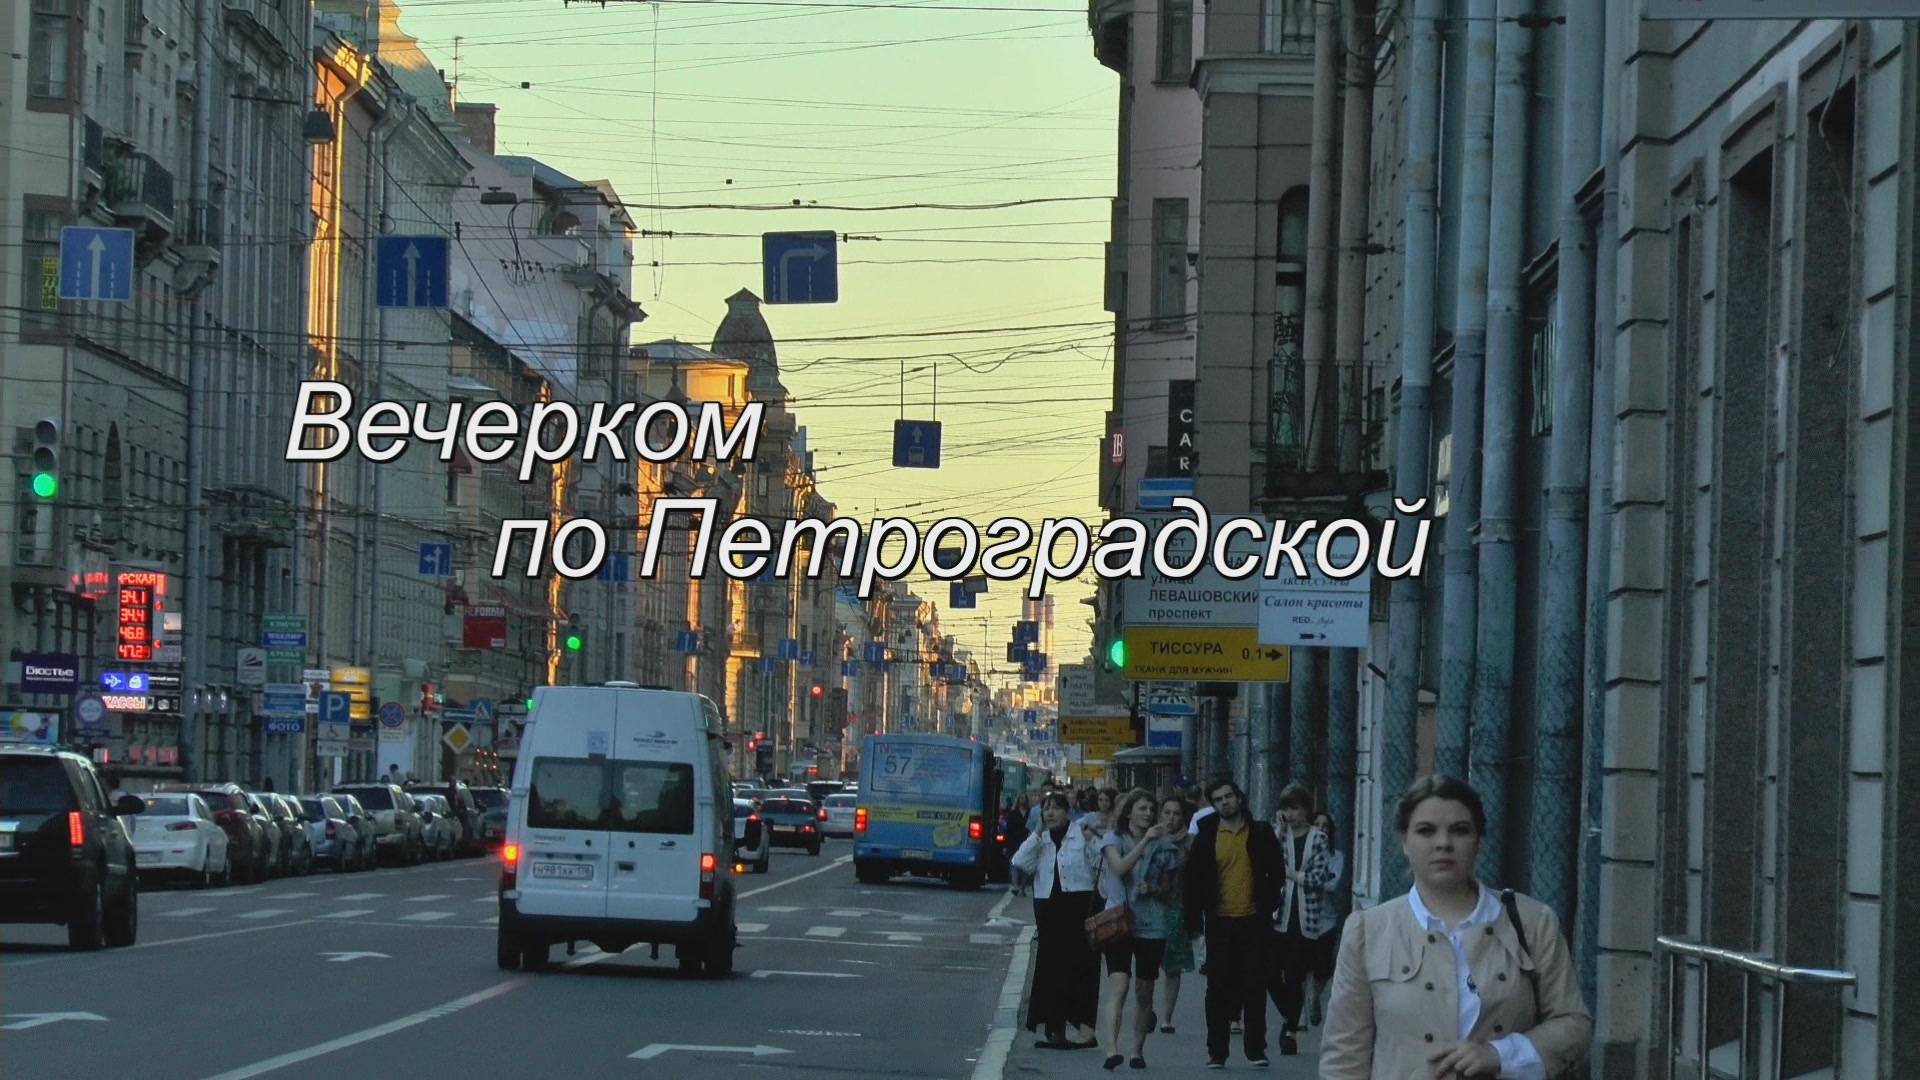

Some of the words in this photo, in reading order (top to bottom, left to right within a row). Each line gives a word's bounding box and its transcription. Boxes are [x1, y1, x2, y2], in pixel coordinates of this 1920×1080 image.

[1265, 596, 1303, 609] Салон
[1307, 598, 1364, 610] красоты
[1148, 608, 1212, 621] проспект
[1150, 641, 1224, 655] ТИССУРА
[1169, 666, 1188, 675] ДЛЯ
[1191, 666, 1233, 675] МУЖЧИН
[268, 722, 300, 731] ФОТО
[884, 755, 913, 775] 57
